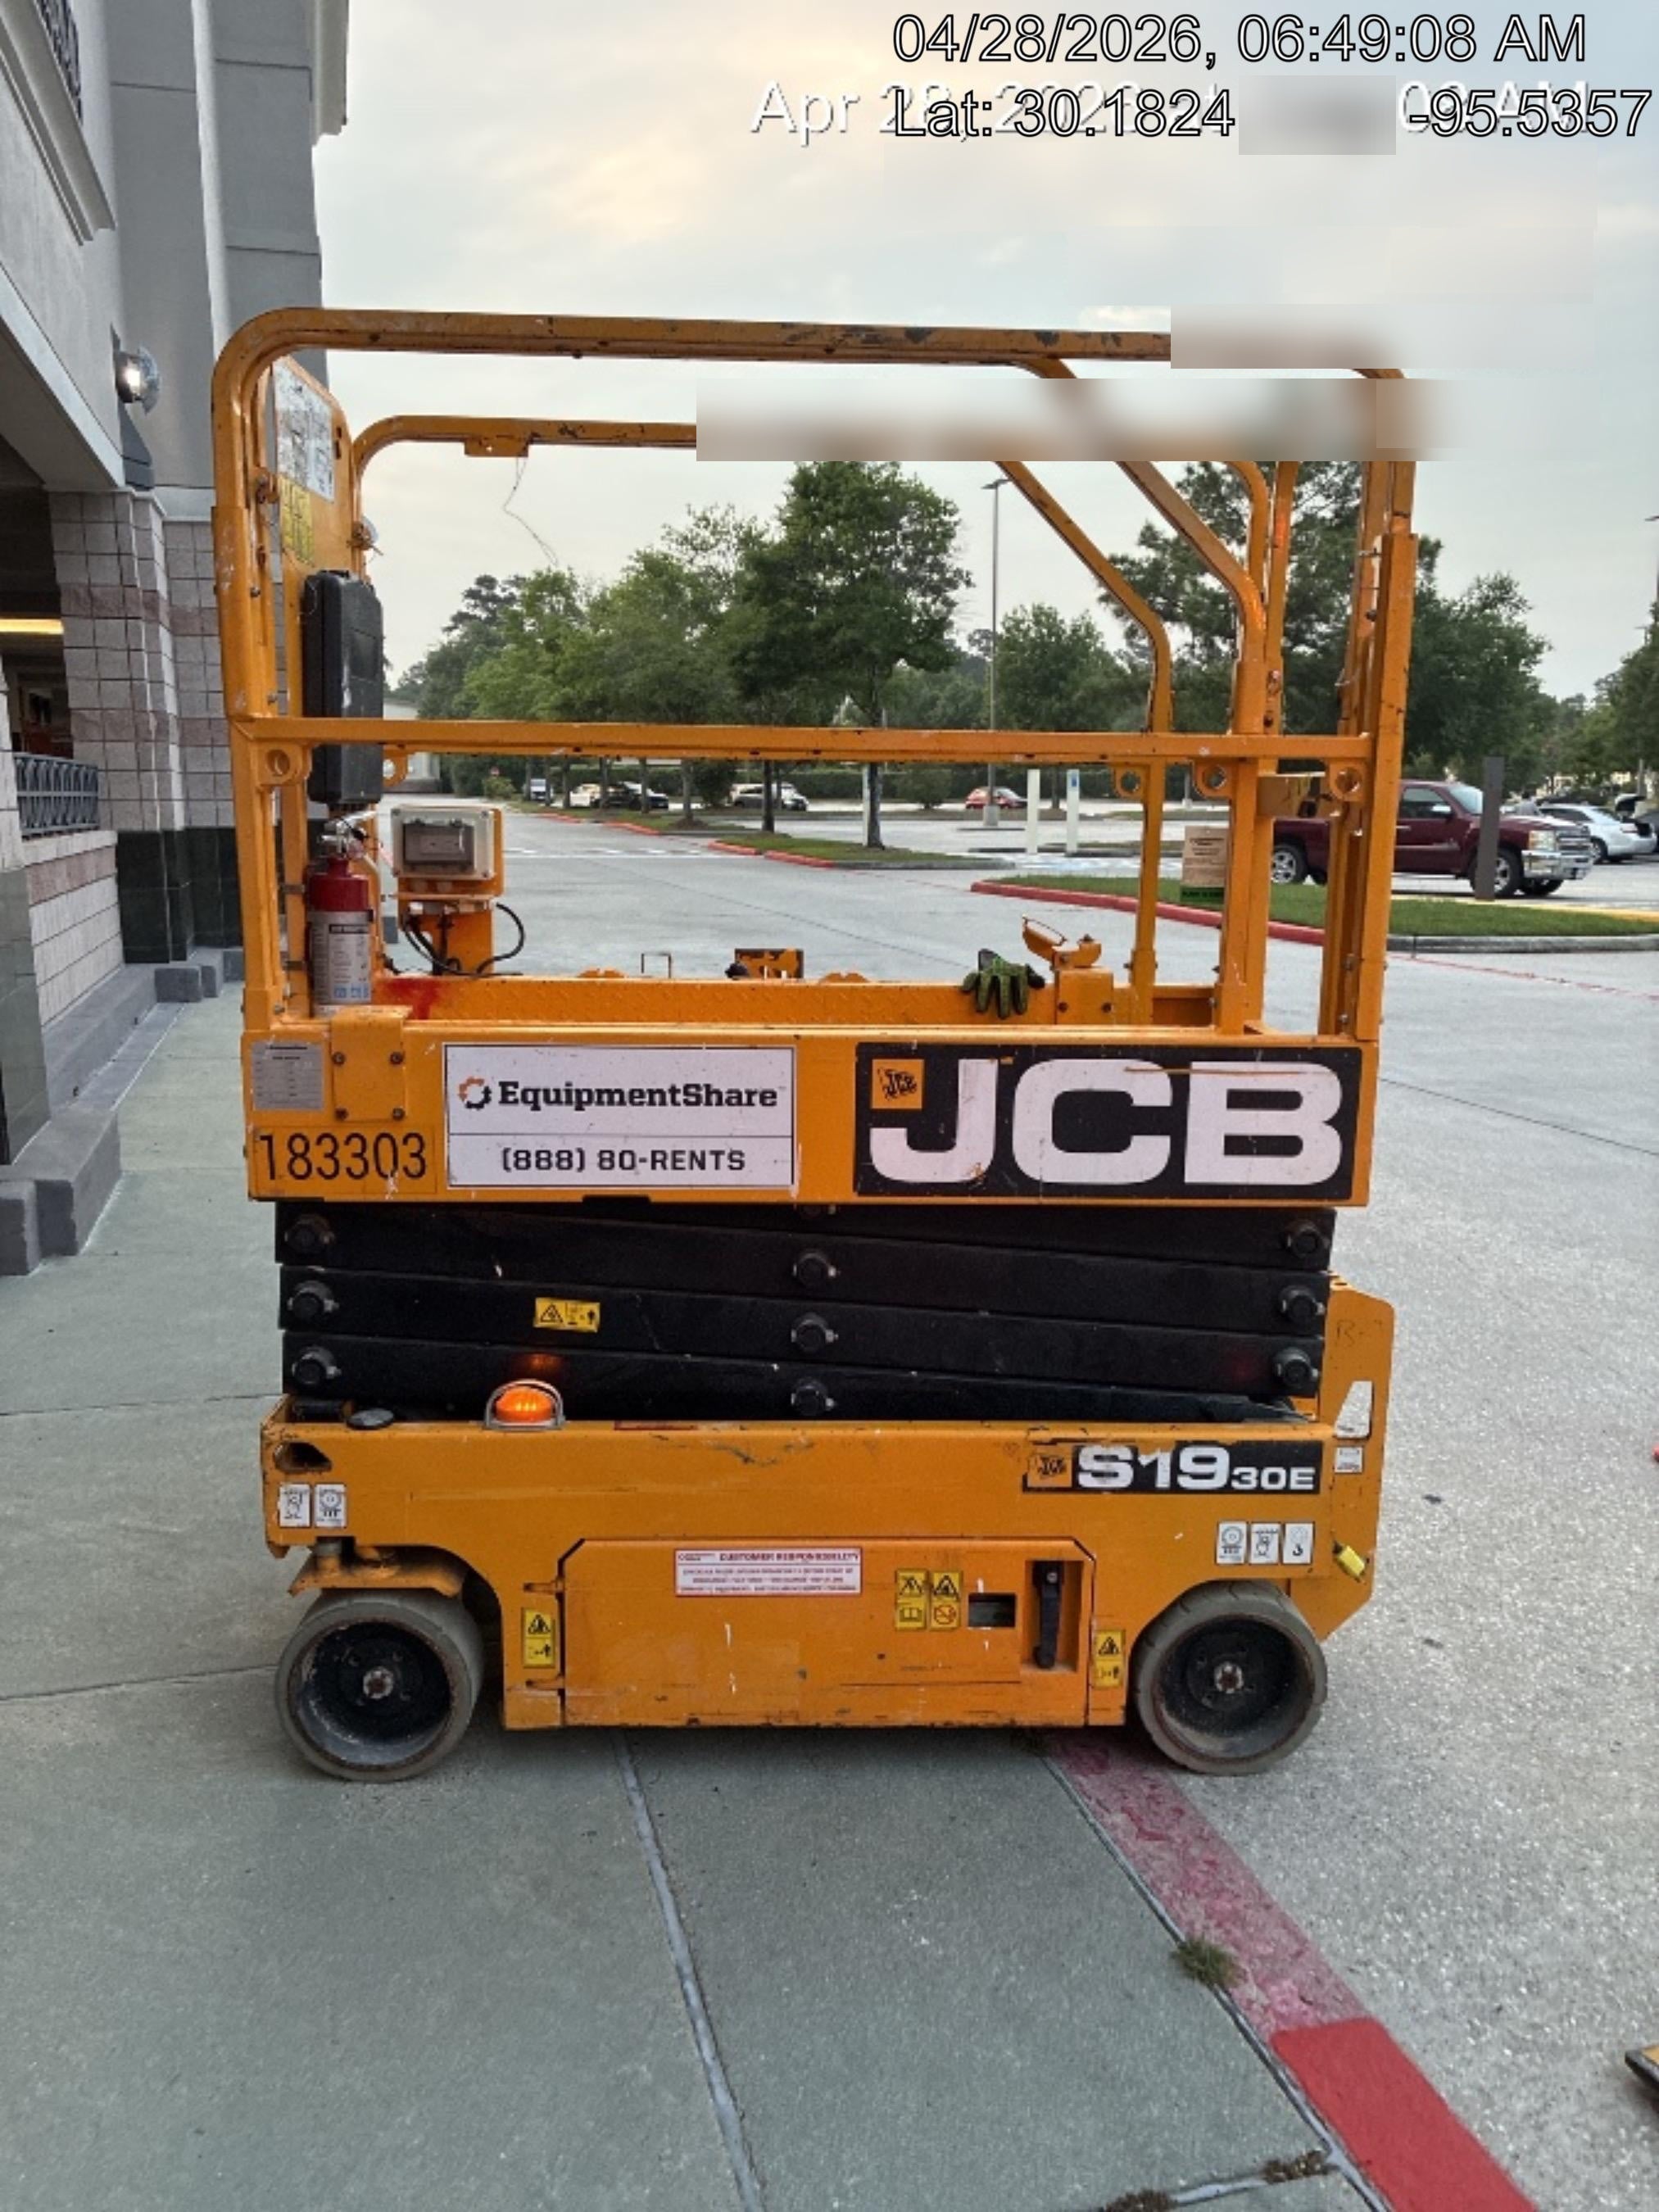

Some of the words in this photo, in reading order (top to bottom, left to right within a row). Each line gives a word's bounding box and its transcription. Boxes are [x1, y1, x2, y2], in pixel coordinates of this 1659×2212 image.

[498, 1081, 777, 1113] EquipmentShare
[869, 1058, 1343, 1186] JCB
[259, 1131, 427, 1181] 183303
[502, 1147, 586, 1172] (888)
[598, 1148, 746, 1172] 80-RENTS
[1077, 1444, 1230, 1490] S19
[1231, 1466, 1315, 1490] 30E
